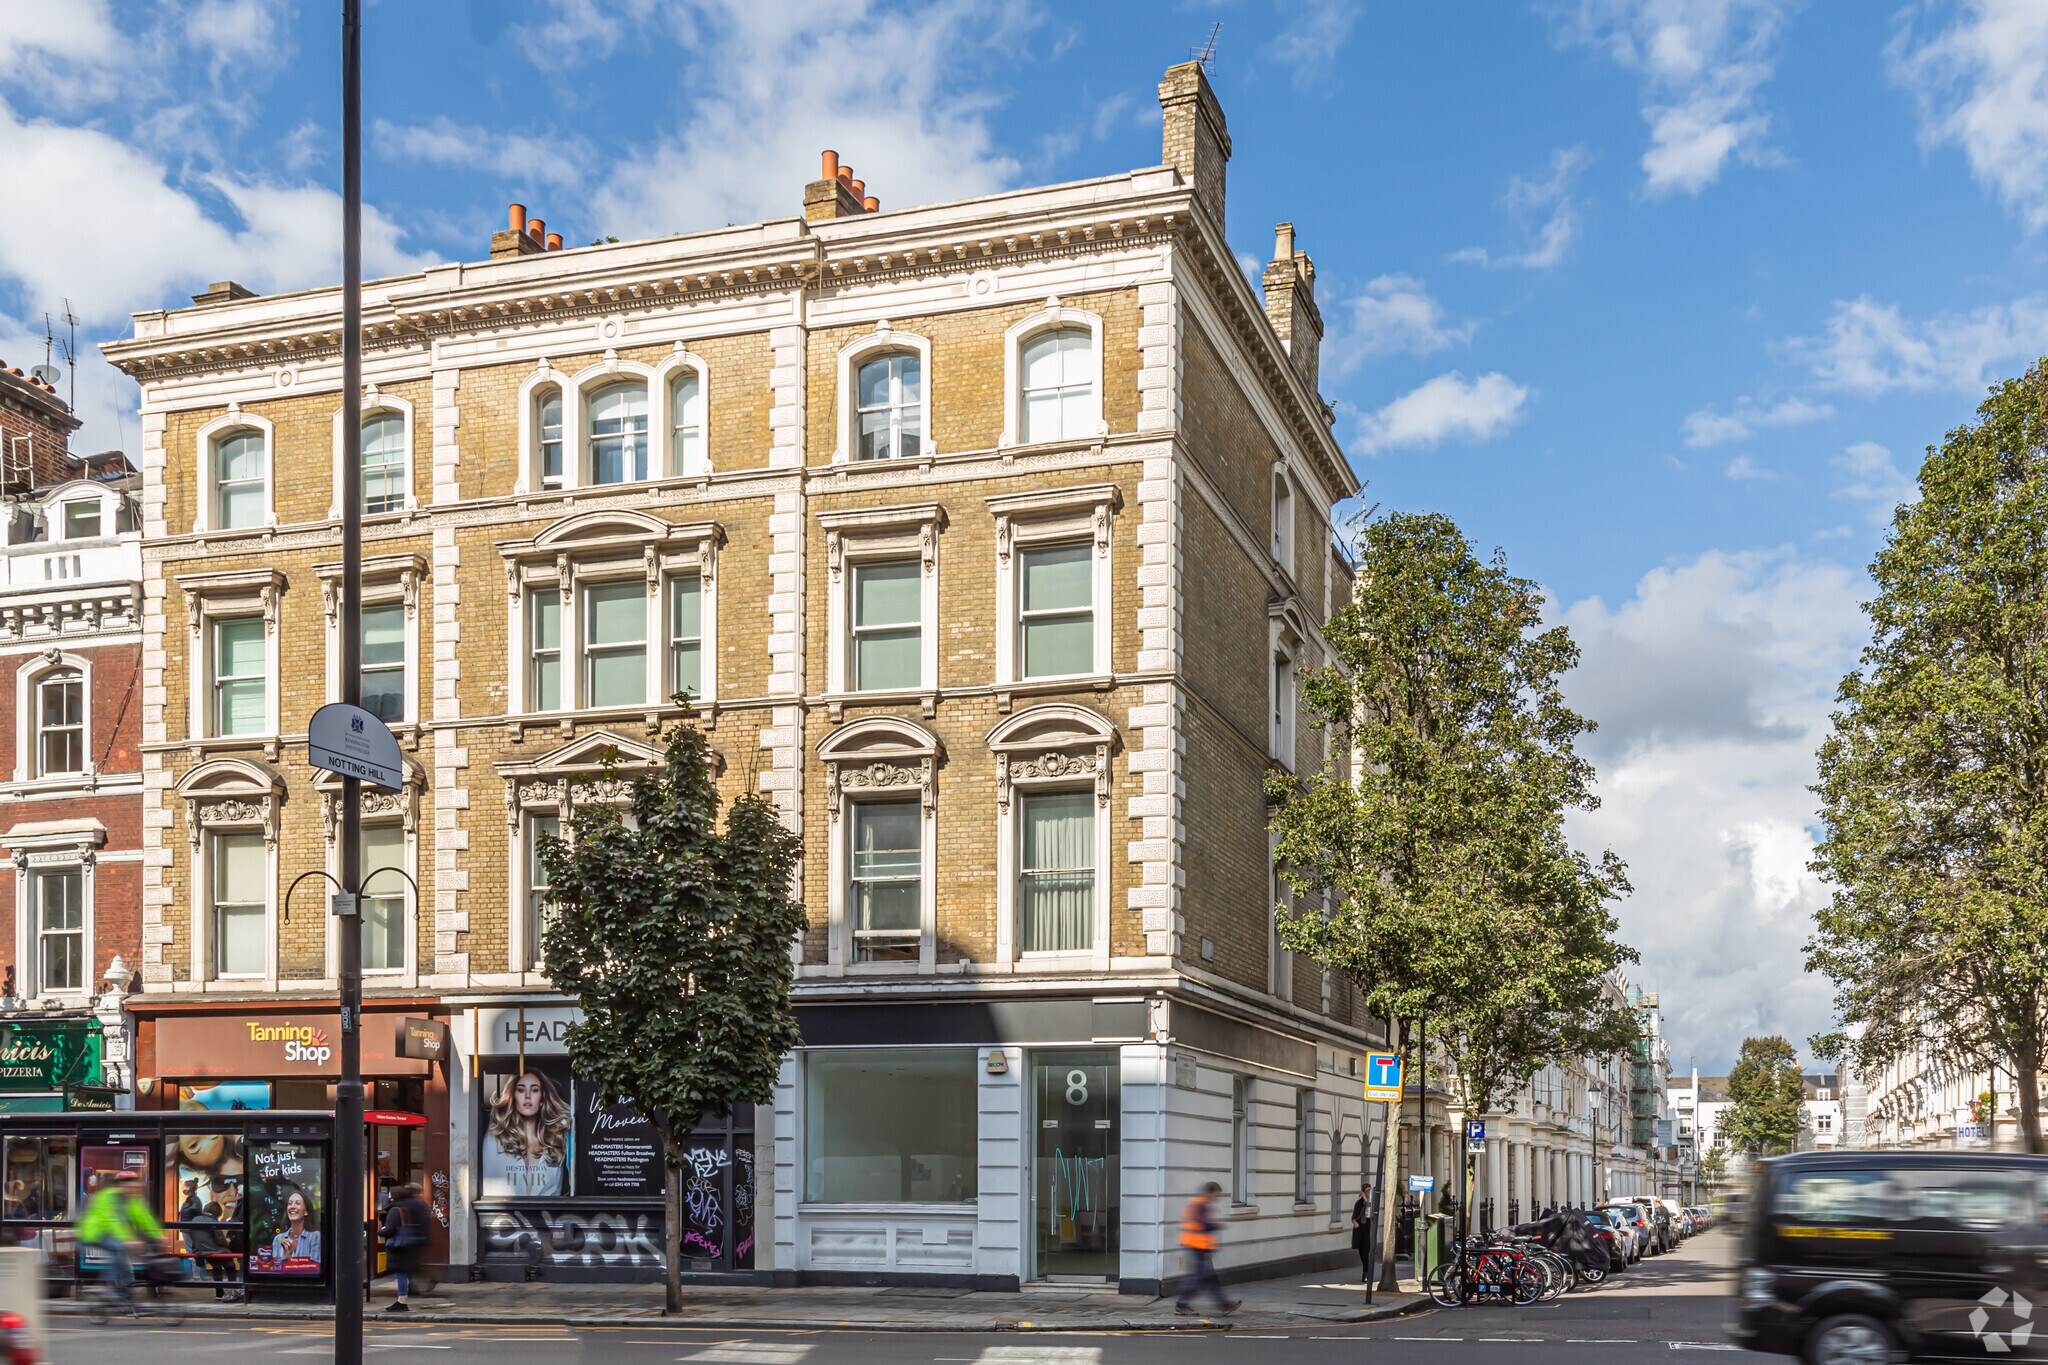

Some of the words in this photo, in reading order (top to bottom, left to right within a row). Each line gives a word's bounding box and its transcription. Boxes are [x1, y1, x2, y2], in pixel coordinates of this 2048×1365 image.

[328, 756, 367, 775] NOTTING
[368, 768, 386, 781] HILL
[246, 1022, 312, 1046] Tanning
[409, 1026, 434, 1041] Tanning
[423, 1037, 441, 1051] Shop
[284, 1041, 331, 1066] Shop
[1065, 1069, 1089, 1106] 8
[83, 1099, 112, 1109] Amicis
[1471, 1124, 1482, 1137] P
[1958, 1126, 1987, 1138] HOTEL
[254, 1152, 275, 1165] Not
[276, 1149, 297, 1165] just
[264, 1165, 280, 1178] for
[281, 1162, 303, 1176] kids
[506, 1172, 547, 1186] HAIR
